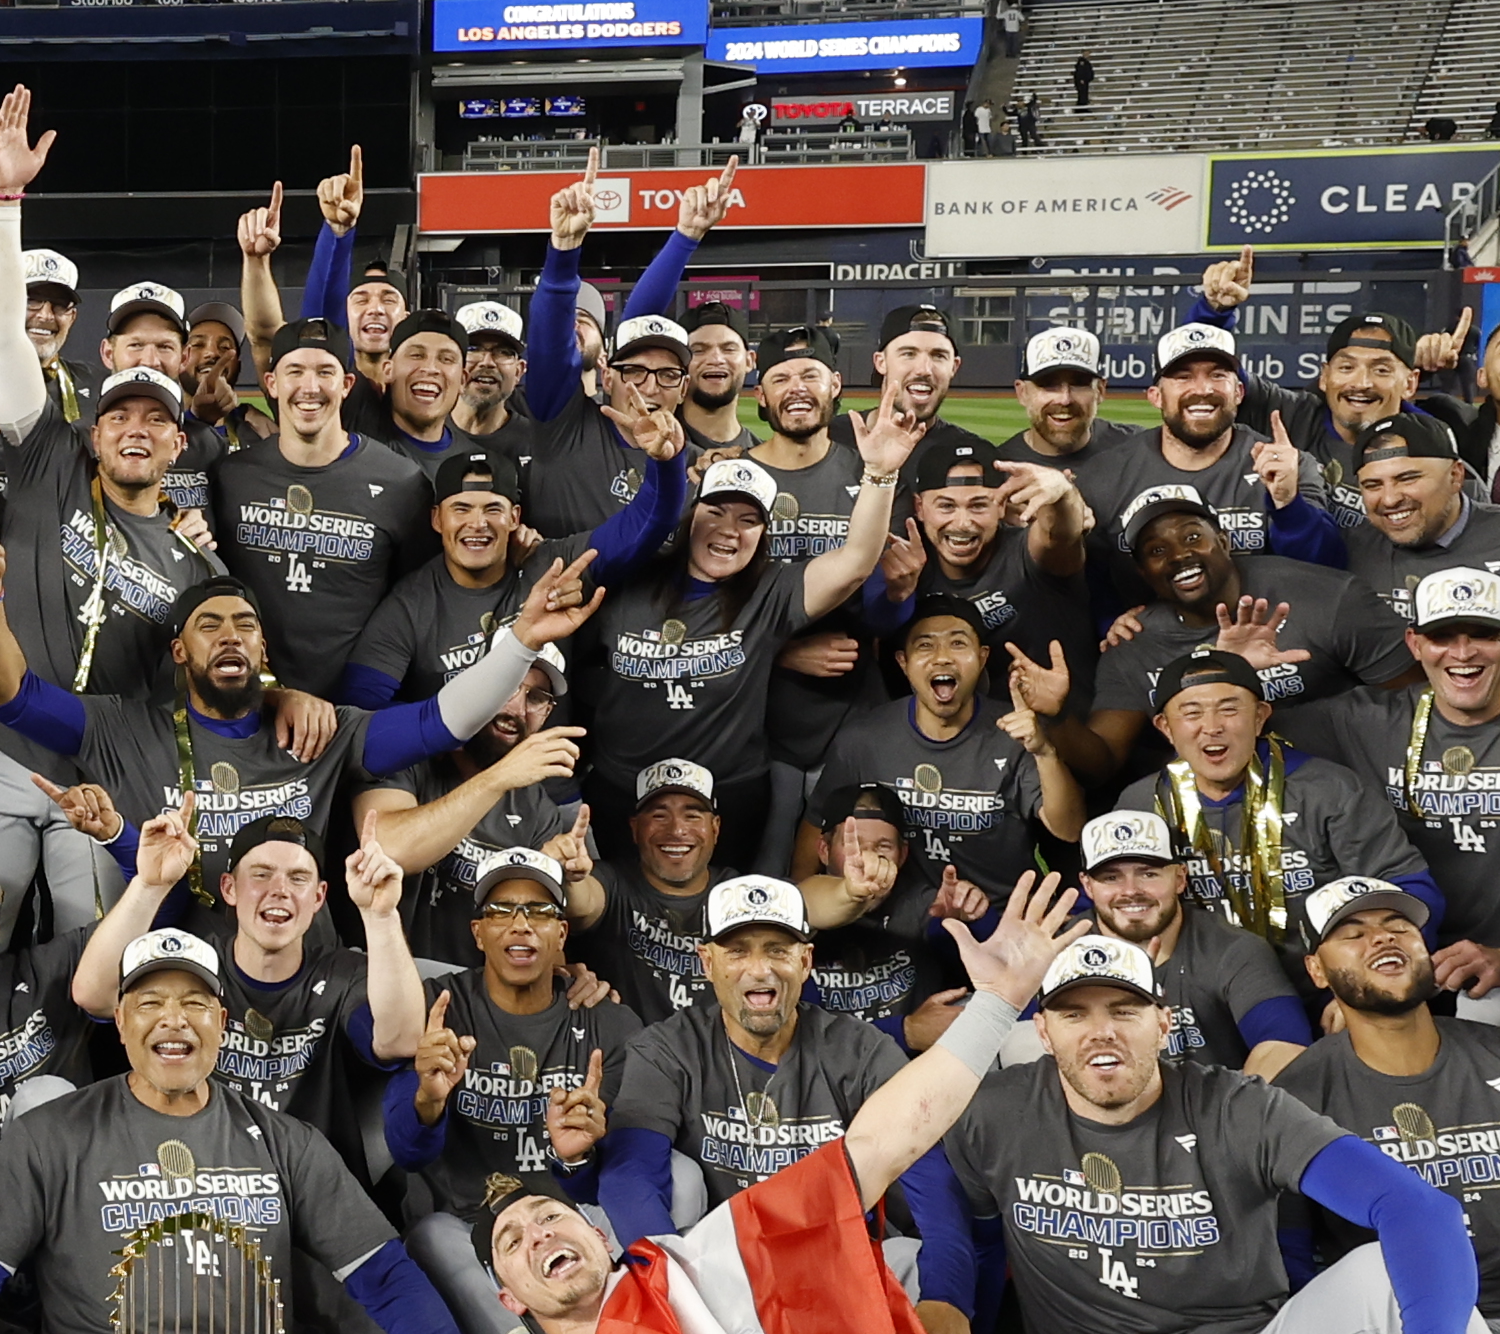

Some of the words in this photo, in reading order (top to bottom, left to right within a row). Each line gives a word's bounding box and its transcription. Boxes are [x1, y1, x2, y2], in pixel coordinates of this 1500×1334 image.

[504, 2, 635, 24] CONGRATULATIONS
[457, 26, 494, 41] LOS
[497, 24, 583, 40] ANGELES
[587, 21, 681, 38] DODGERS
[726, 40, 762, 61] 2024
[764, 37, 815, 59] WORLD
[818, 36, 867, 58] SERIES
[868, 32, 959, 56] CHAMPIONS
[773, 102, 853, 119] TOYOTA
[857, 97, 950, 116] TERRACE
[934, 202, 994, 215] BANK
[1001, 200, 1030, 213] OF
[1034, 197, 1138, 213] AMERICA
[1321, 181, 1475, 214] CLEAR
[240, 505, 307, 530] WORLD
[309, 515, 375, 540] SERIES
[236, 523, 372, 560] CHAMPIONS
[285, 554, 311, 593] LA
[99, 1178, 193, 1201] WORLD
[196, 1173, 279, 1195] SERIES
[1015, 1177, 1120, 1214] WORLD
[1122, 1190, 1212, 1216] SERIES
[1013, 1204, 1220, 1248] CHAMPIONS
[1098, 1248, 1138, 1297] LA
